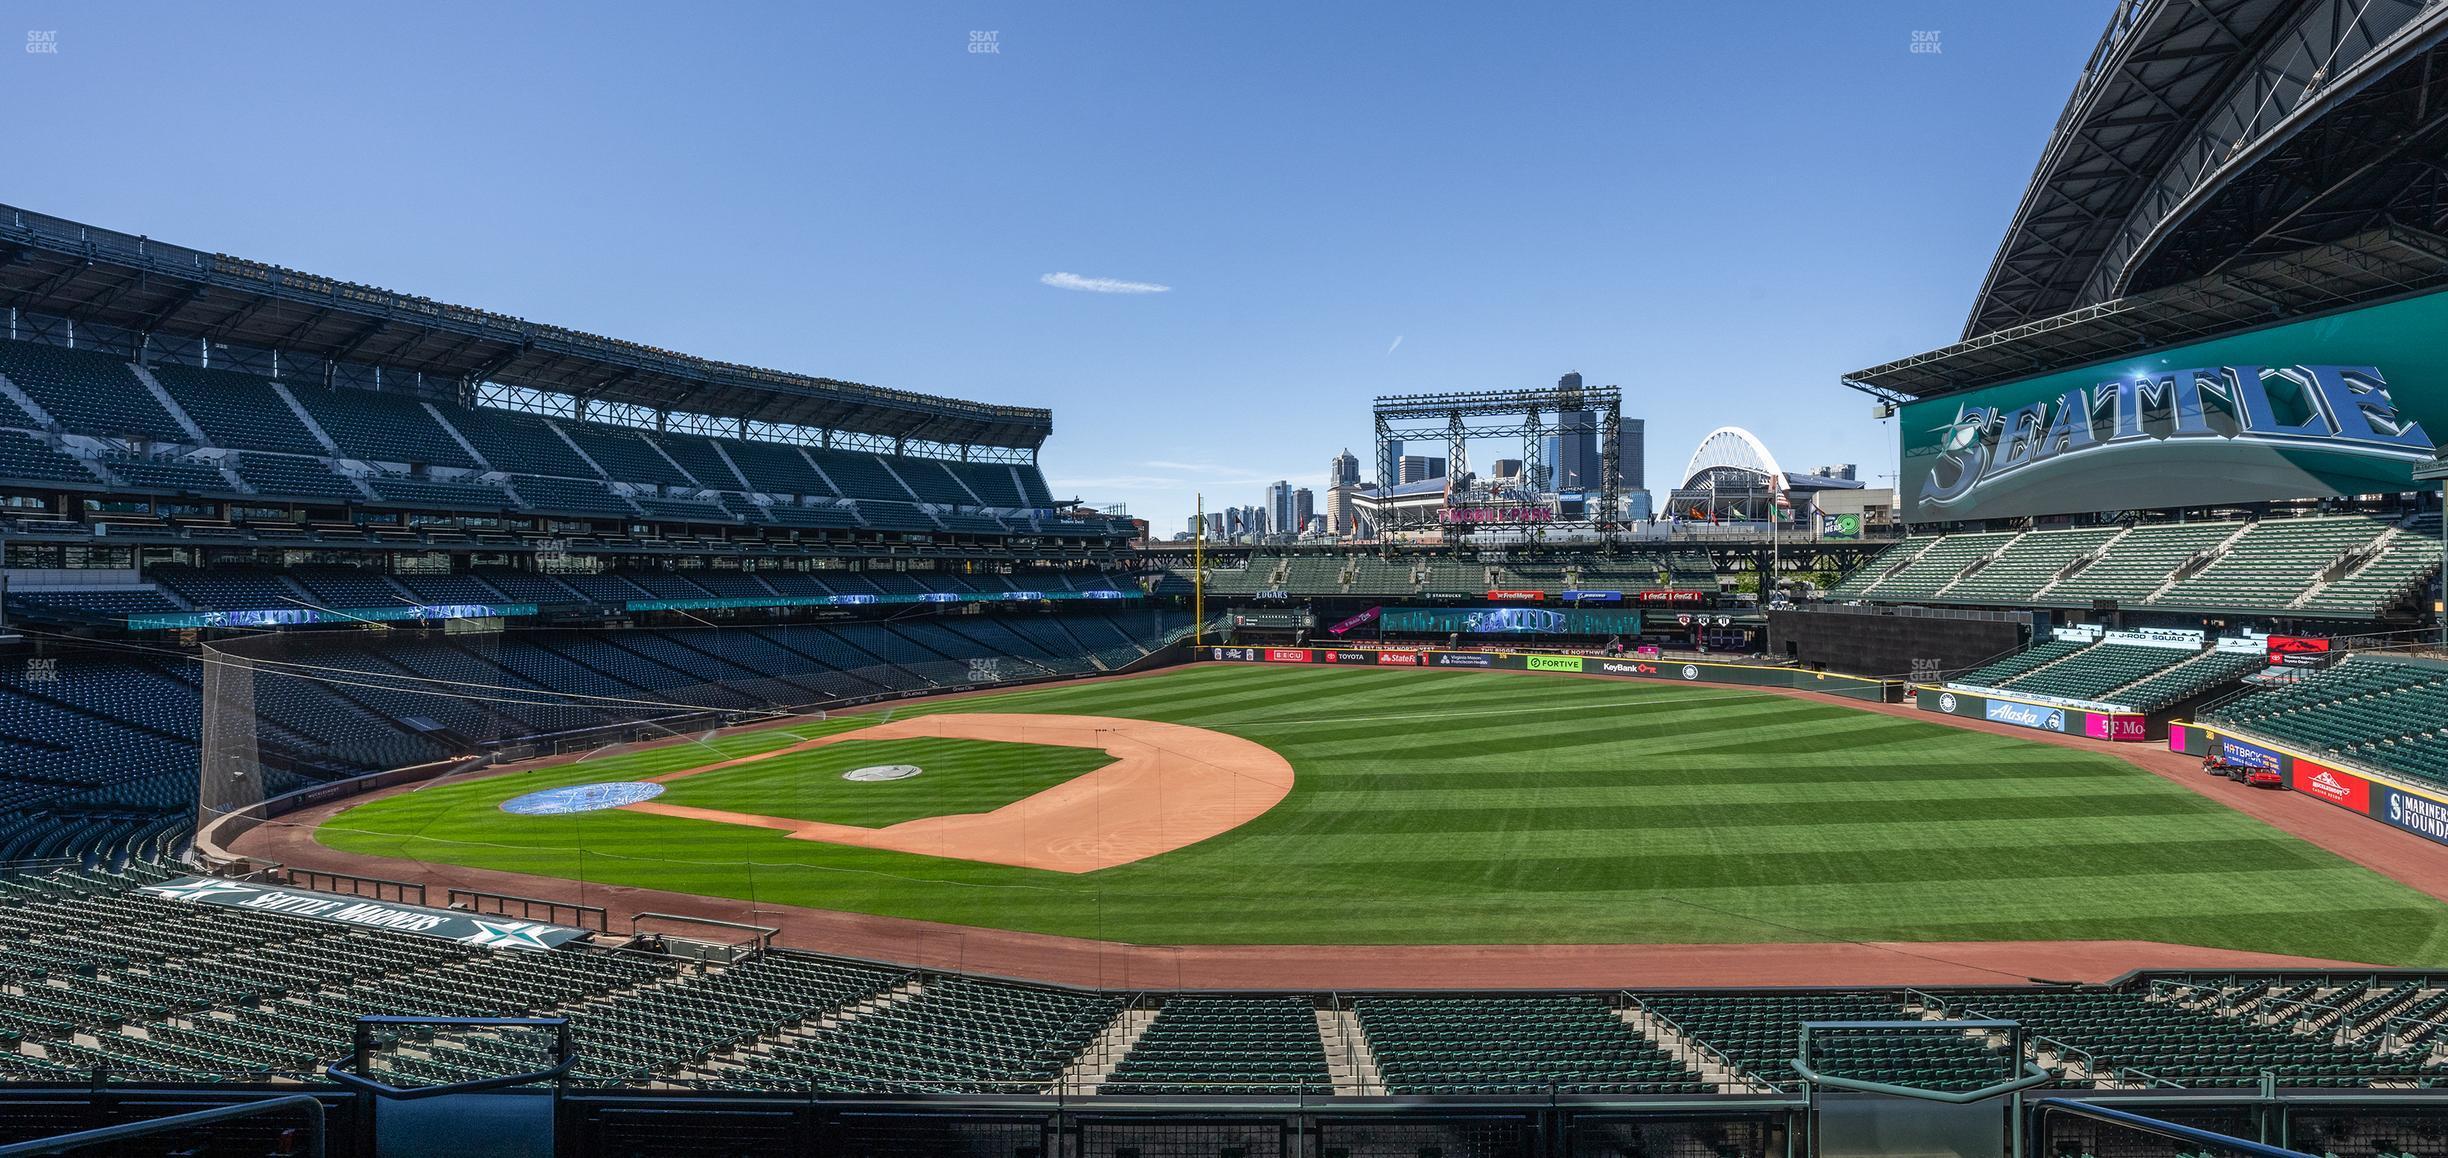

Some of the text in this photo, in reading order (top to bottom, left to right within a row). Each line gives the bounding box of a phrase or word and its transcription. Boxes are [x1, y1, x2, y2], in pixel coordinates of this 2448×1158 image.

[1918, 365, 2437, 506] SEATTLE
[2151, 634, 2185, 642] SQUAD
[1276, 652, 1302, 660] BECU
[1542, 657, 1579, 668] FORTIVE
[1604, 663, 1638, 672] KeyBank
[1990, 704, 2037, 724] Alaska
[2223, 742, 2263, 763] HATBACK
[238, 891, 451, 932] SEATTLE MARINERS
